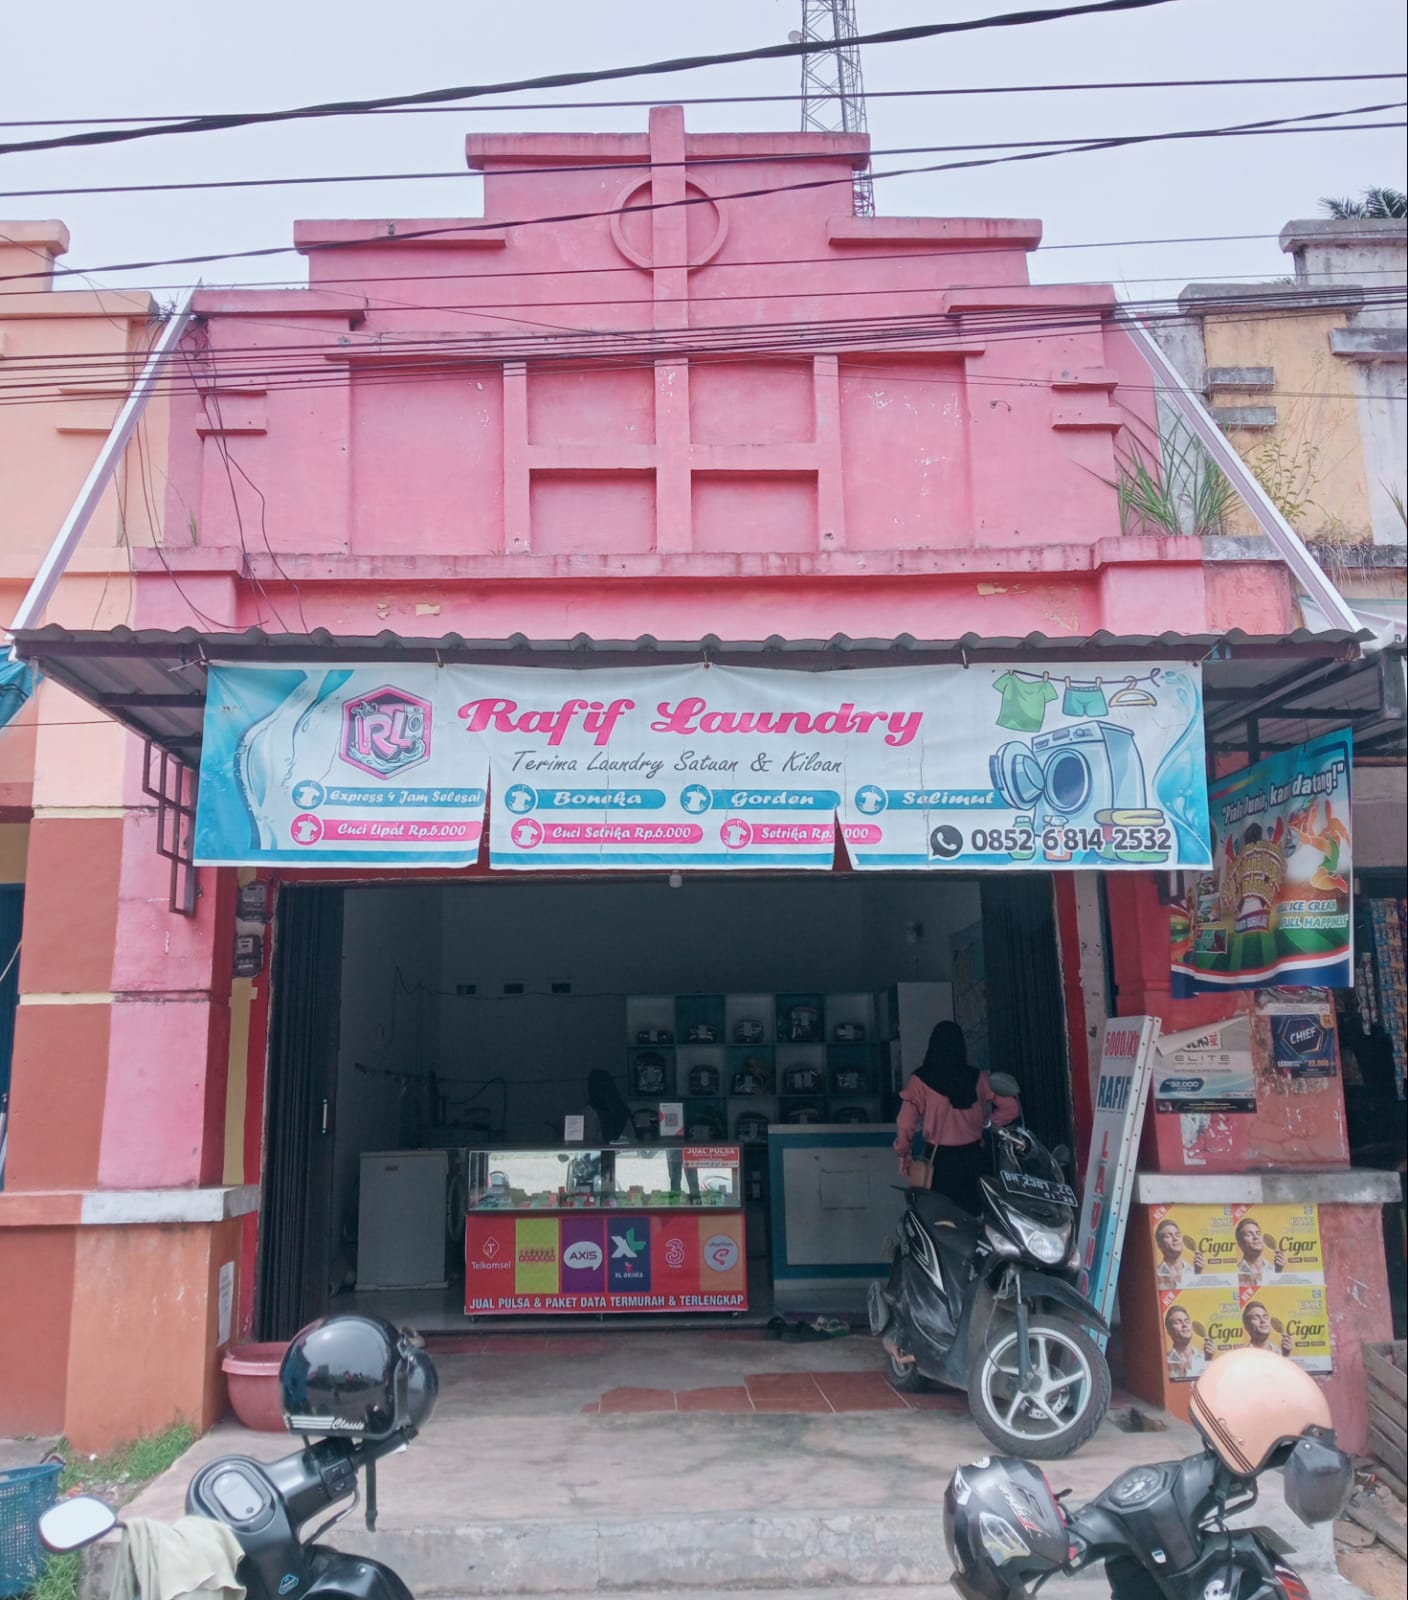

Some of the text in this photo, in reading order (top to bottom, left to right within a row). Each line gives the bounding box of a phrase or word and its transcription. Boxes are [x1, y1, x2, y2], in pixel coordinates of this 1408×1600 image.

[456, 697, 923, 746] Rafif Laundry
[512, 750, 842, 779] Terima Laundry Satuan & Kiloan
[330, 790, 480, 803] Express 4 Jam Selesai
[553, 791, 641, 805] Boneka
[730, 791, 814, 806] Gorden
[902, 791, 994, 806] Selimut
[337, 823, 466, 838] Cuci Lipat Rp.5.000
[552, 826, 692, 840] Cuci Setrika Rp.6.000
[761, 827, 808, 840] Setrika
[971, 828, 1172, 852] 0852 6814 2532
[1290, 1027, 1316, 1044] CHIEF
[1175, 1054, 1231, 1063] ELITE
[1198, 1237, 1236, 1257] Cigar
[1279, 1236, 1317, 1256] Cigar
[471, 1261, 511, 1271] Telkomsel
[469, 1294, 744, 1309] JUAL PULSA & PAKET DATA TERMURAH & TERLENGKAP
[1286, 1320, 1325, 1339] Cigar
[331, 1417, 365, 1430] Classic
